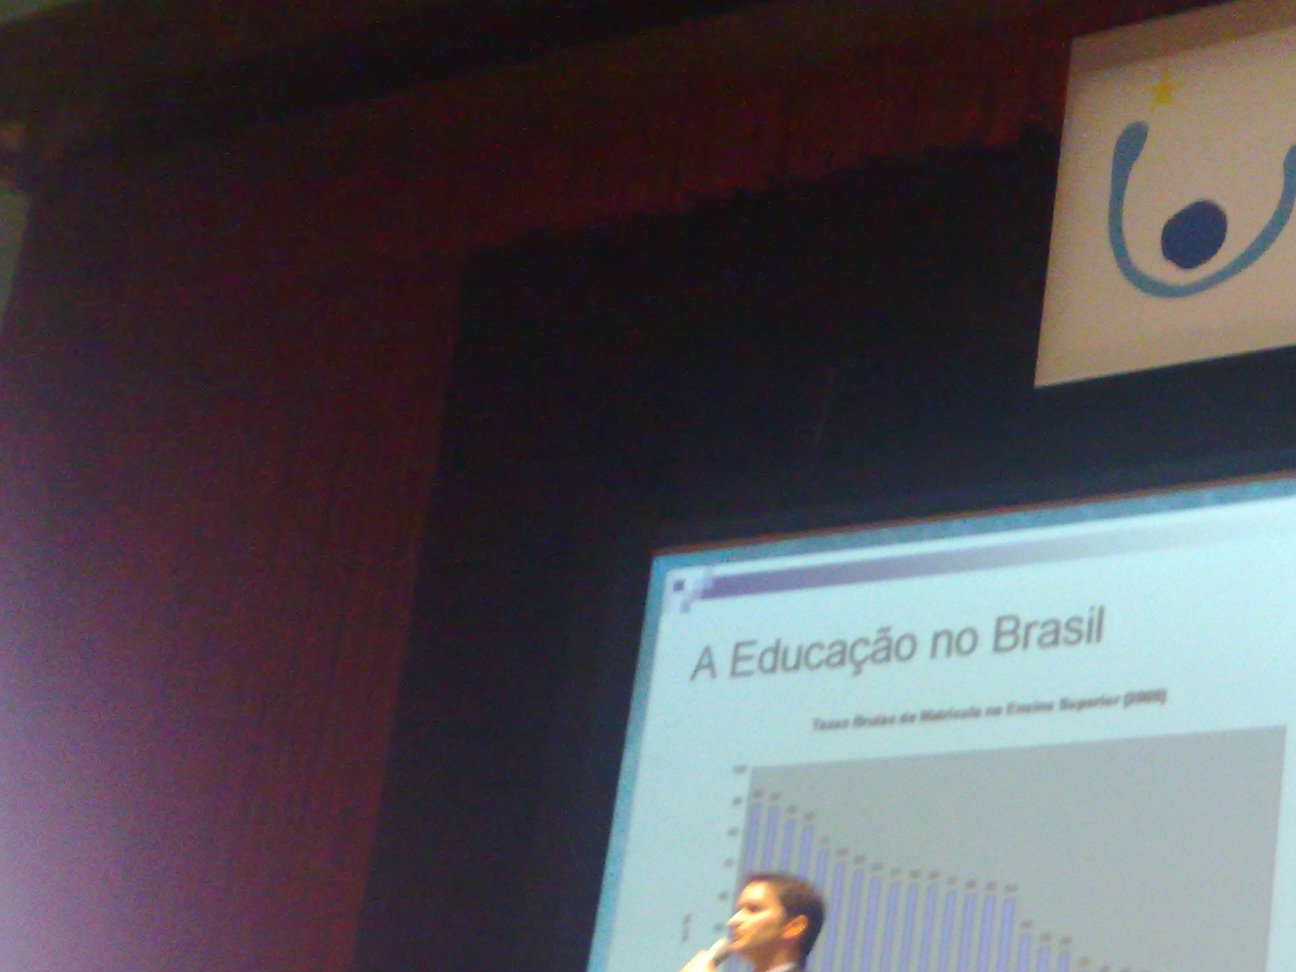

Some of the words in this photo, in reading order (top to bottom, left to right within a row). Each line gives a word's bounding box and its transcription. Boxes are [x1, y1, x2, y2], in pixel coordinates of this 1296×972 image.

[689, 645, 718, 682] A
[729, 625, 919, 677] Educação
[928, 625, 980, 660] no
[992, 604, 1107, 655] Brasil
